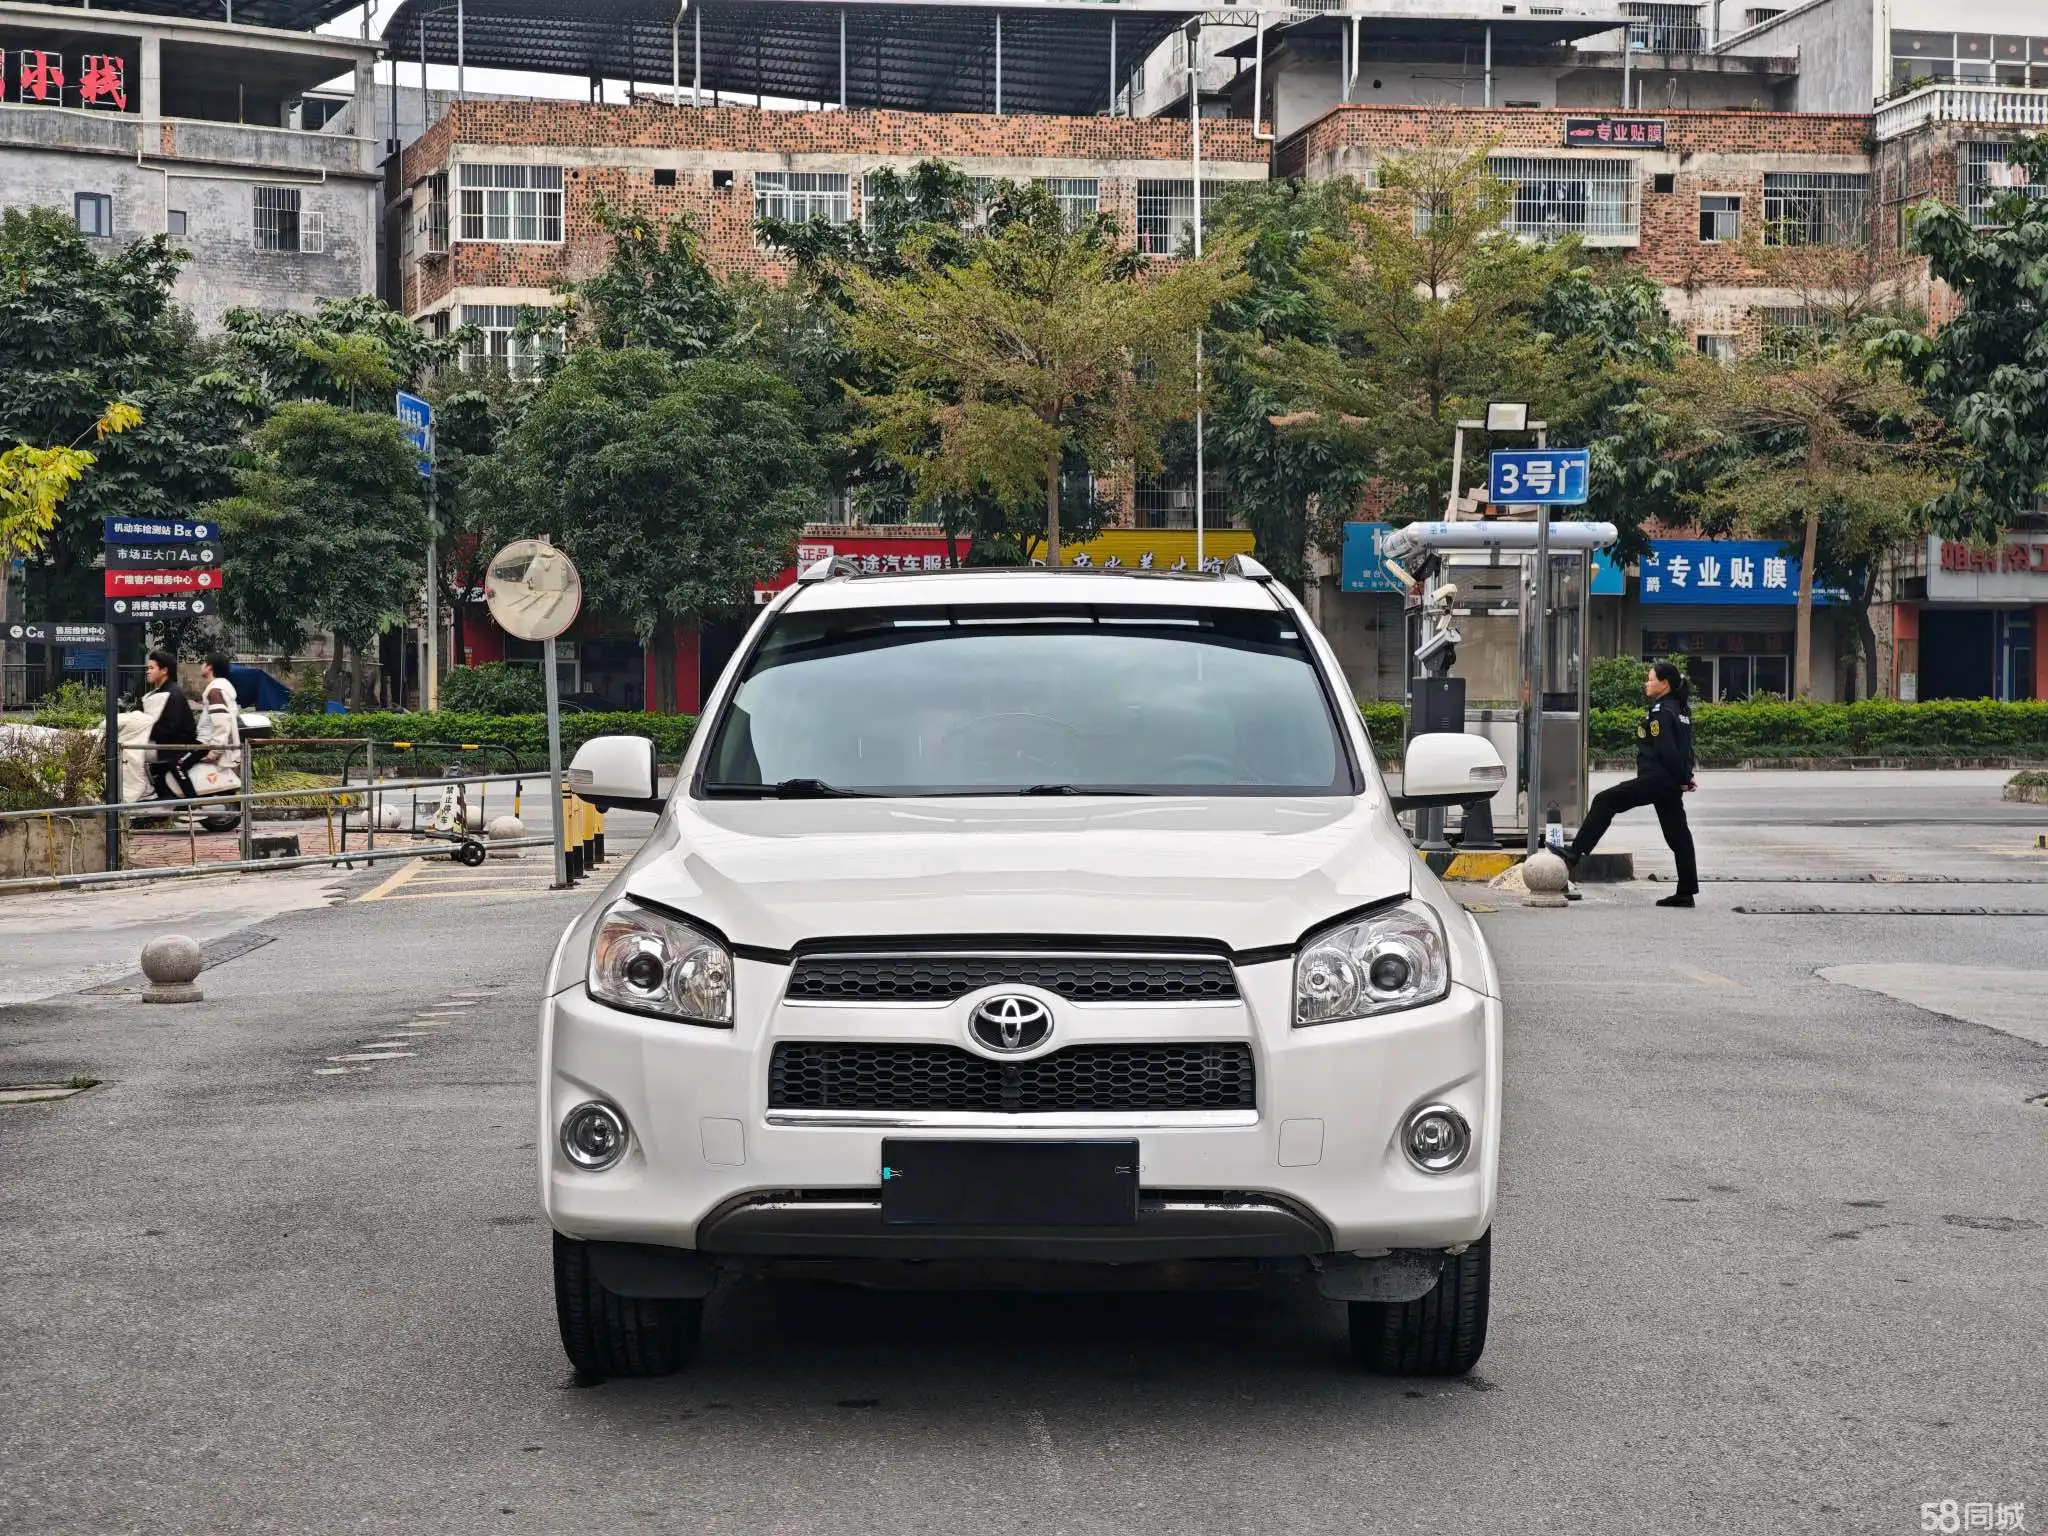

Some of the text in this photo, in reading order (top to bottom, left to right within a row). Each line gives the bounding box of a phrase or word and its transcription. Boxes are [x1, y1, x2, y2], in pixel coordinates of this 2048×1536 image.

[0, 48, 126, 110] 小栈
[1597, 123, 1662, 142] 专业贴膜
[1500, 460, 1585, 495] 3号门
[114, 523, 192, 537] 机动车检测站 B区
[117, 548, 198, 561] 市场正大门 A区
[1667, 555, 1788, 589] 专业贴膜
[131, 601, 187, 611] 消费者停车区
[26, 626, 45, 638] C区
